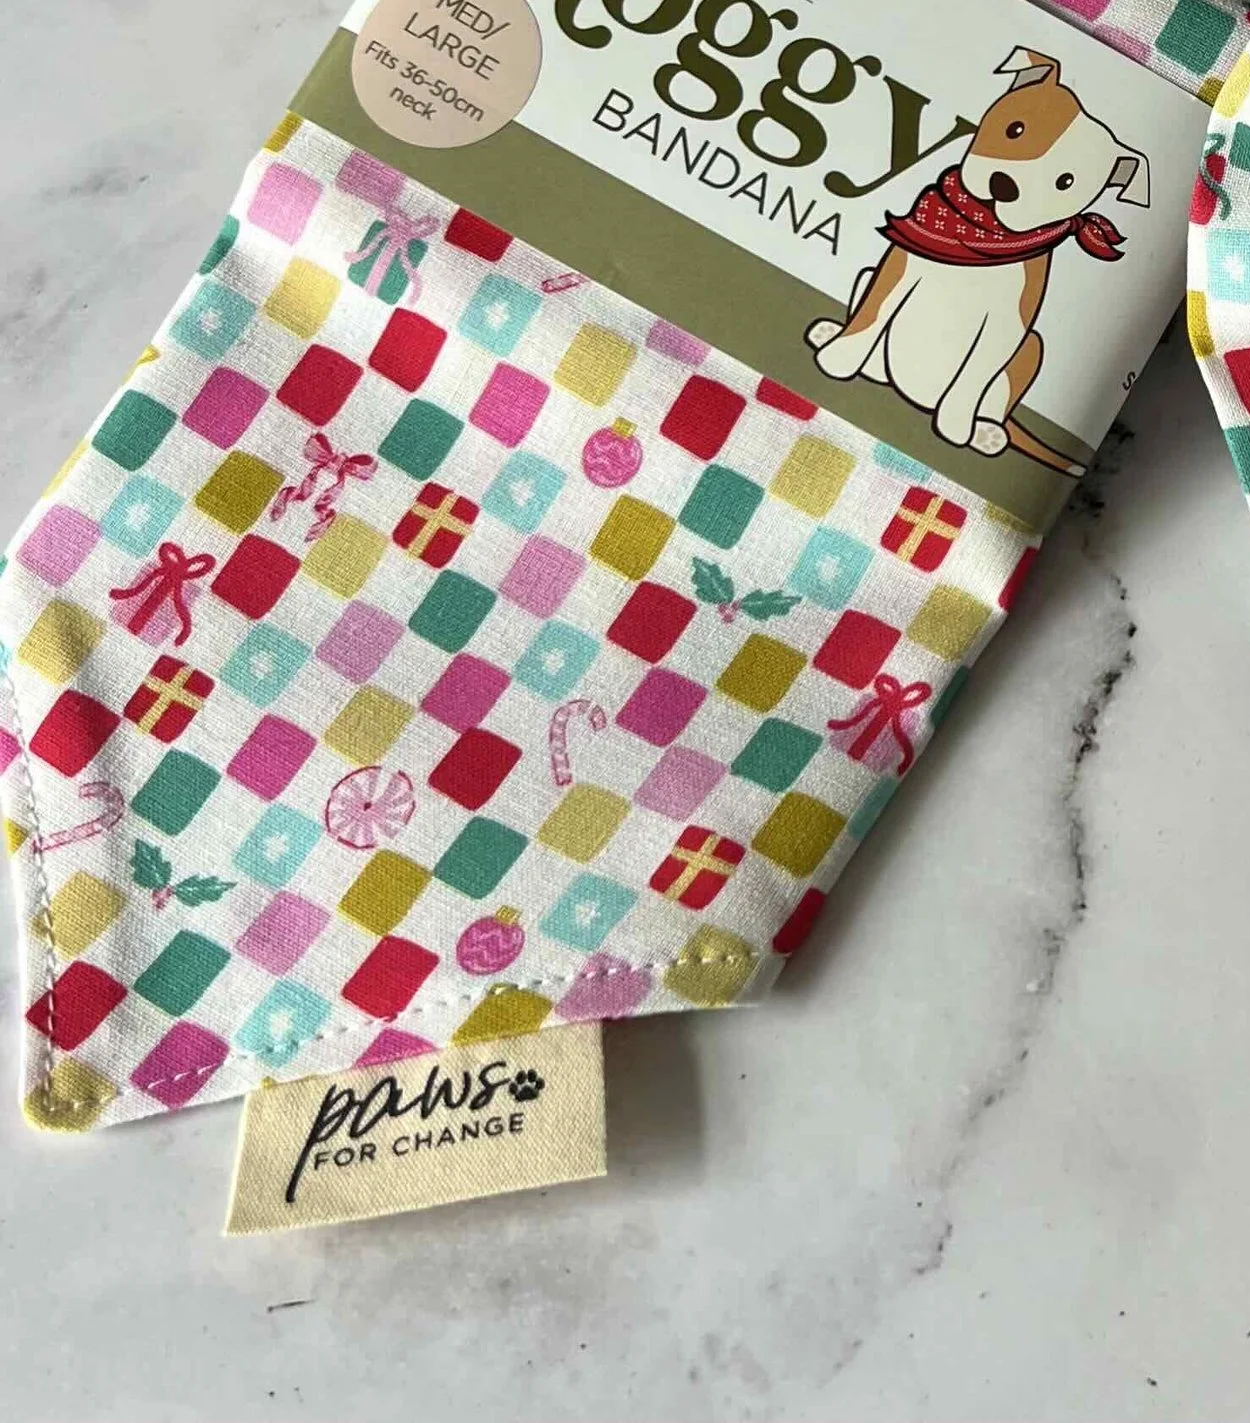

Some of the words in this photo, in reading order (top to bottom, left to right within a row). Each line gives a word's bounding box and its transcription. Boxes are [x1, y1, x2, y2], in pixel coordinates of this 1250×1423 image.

[364, 39, 399, 72] Fits
[399, 59, 485, 124] 36-50cm
[403, 12, 501, 81] LARGE
[388, 86, 437, 122] neck
[592, 87, 843, 256] BANDANA
[285, 1061, 510, 1203] paws
[313, 1142, 378, 1171] FOR
[392, 1112, 526, 1157] CHANGE
